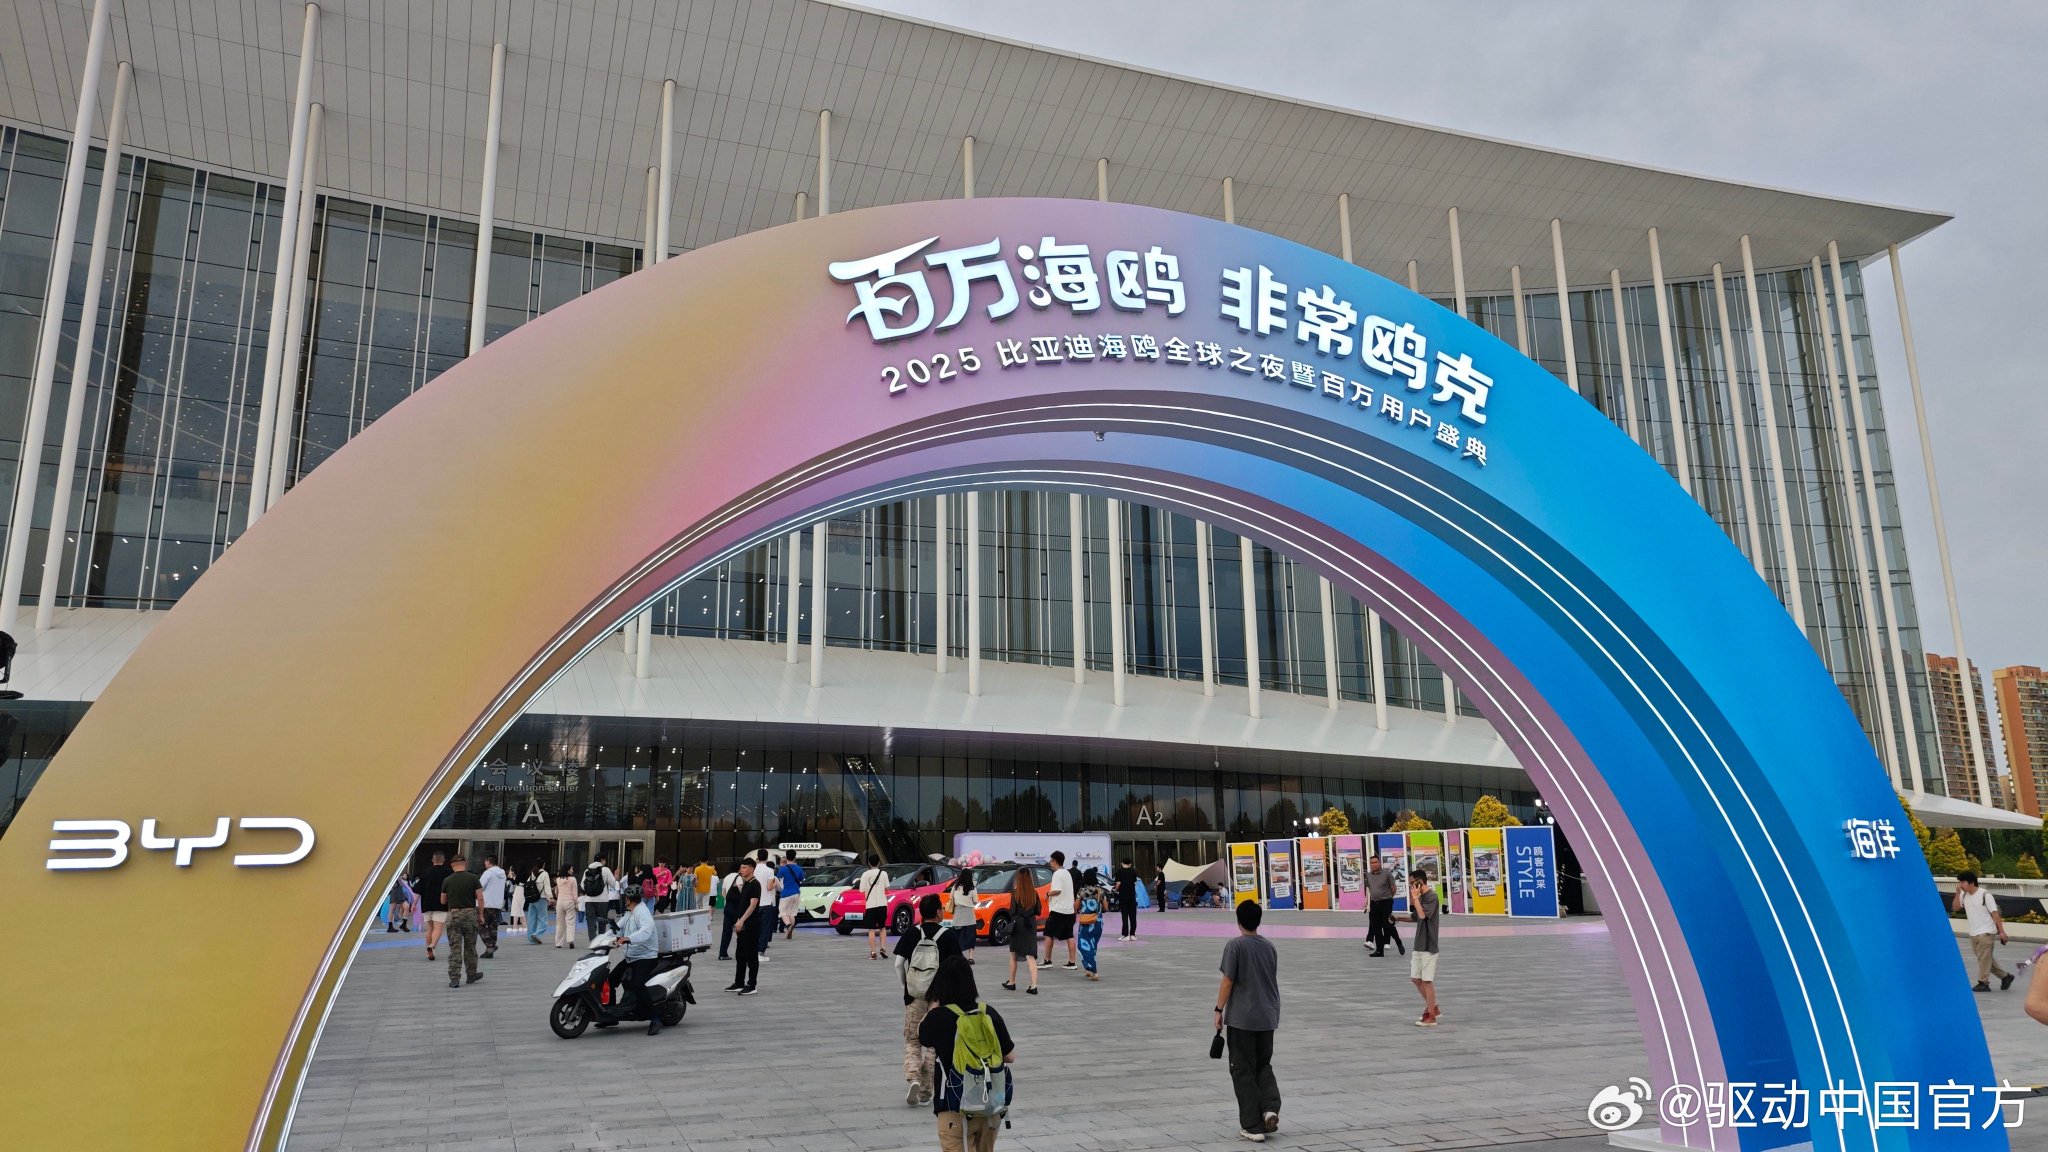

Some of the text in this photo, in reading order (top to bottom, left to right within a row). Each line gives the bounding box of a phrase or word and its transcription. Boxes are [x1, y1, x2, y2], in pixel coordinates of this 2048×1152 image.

[828, 236, 1493, 425] 百万海鸥 非常鸥克
[880, 333, 1489, 468] 2025 比亚迪海鸥全球之夜暨百万用户盛典
[487, 783, 579, 792] Convention Center
[521, 799, 544, 824] A
[1136, 805, 1164, 826] A2
[46, 817, 315, 870] BYD
[1847, 818, 1901, 859] 海洋
[1516, 846, 1535, 899] STYLE
[1533, 846, 1547, 889] 鸥客风采
